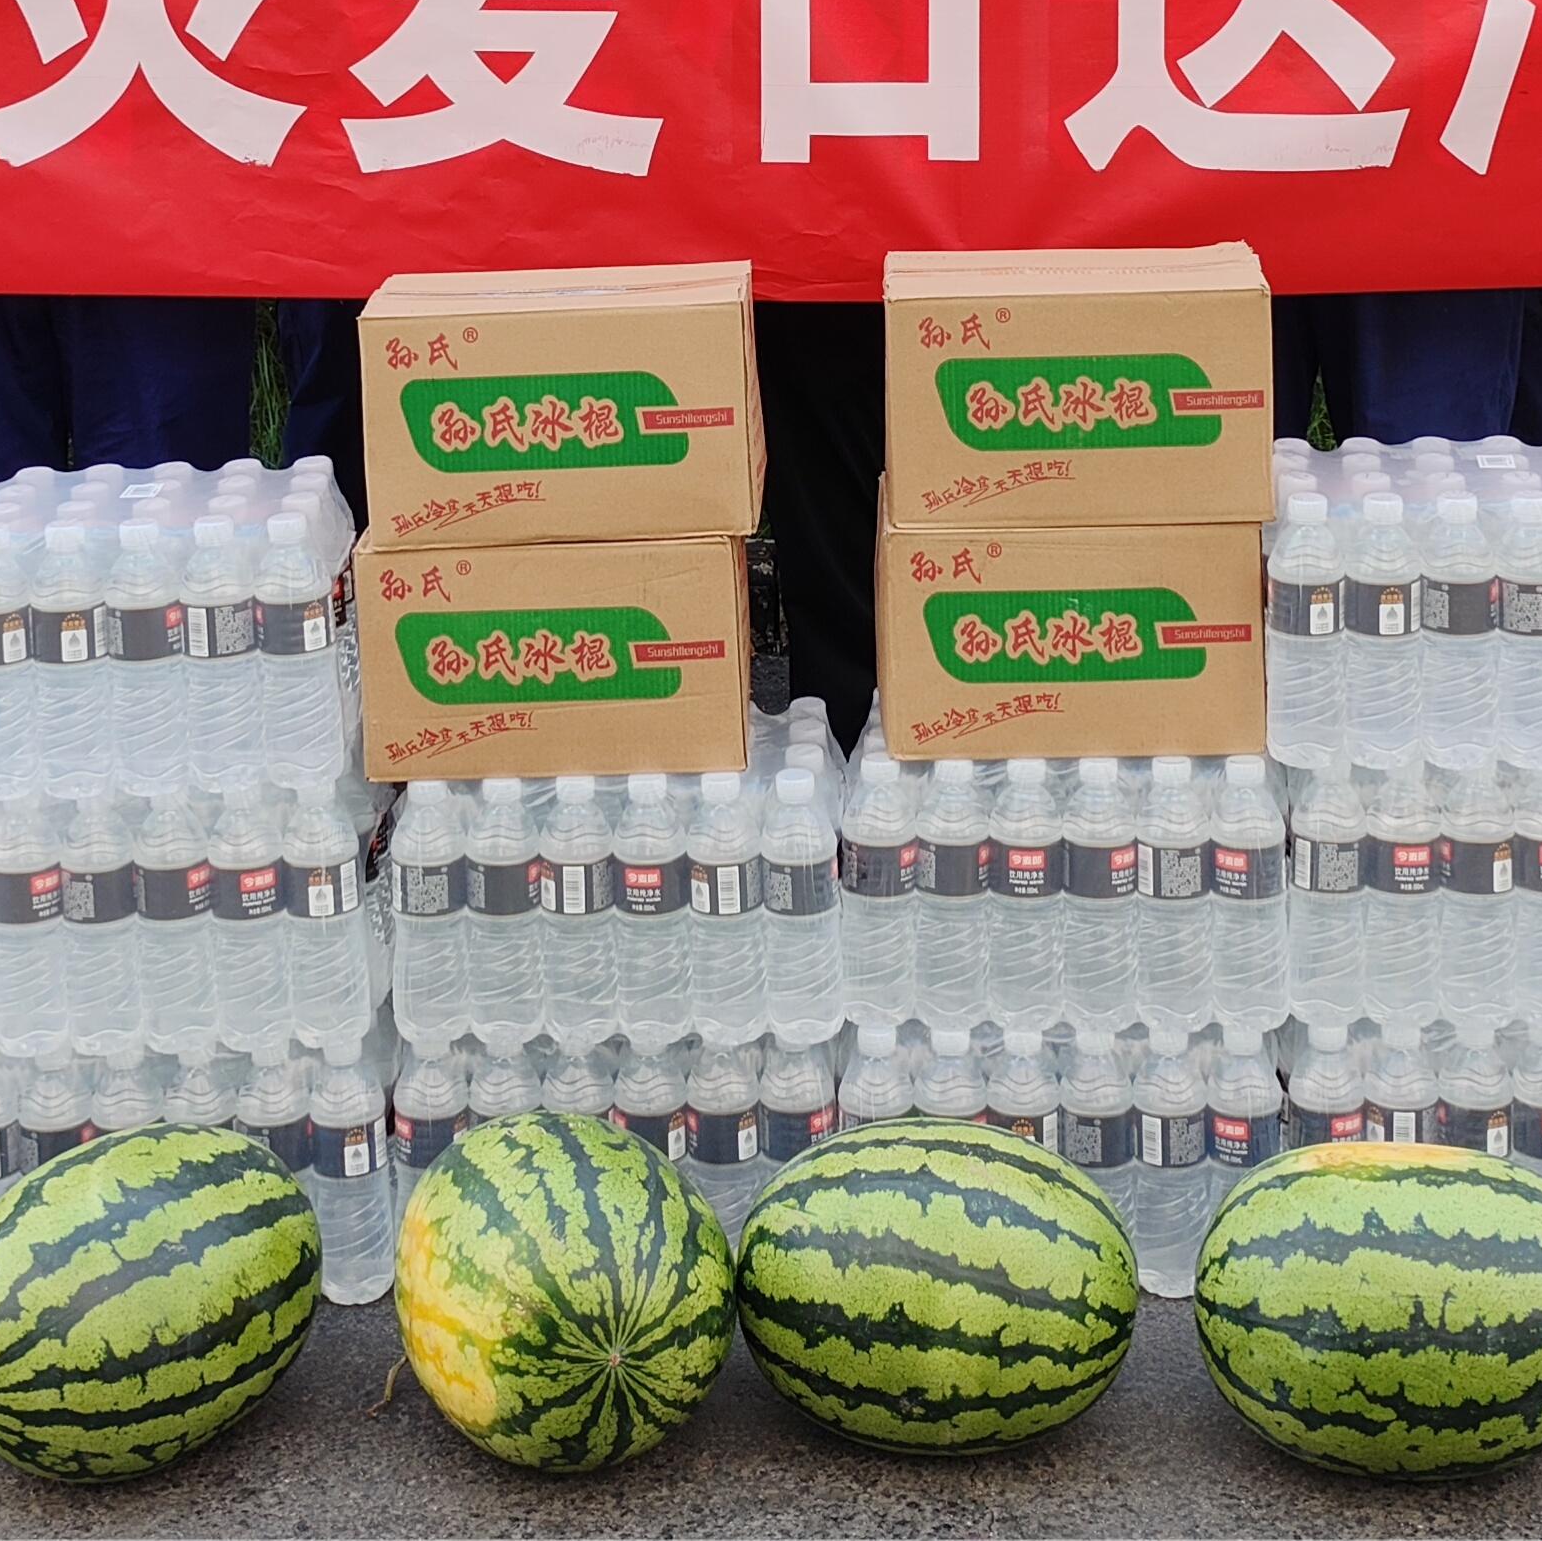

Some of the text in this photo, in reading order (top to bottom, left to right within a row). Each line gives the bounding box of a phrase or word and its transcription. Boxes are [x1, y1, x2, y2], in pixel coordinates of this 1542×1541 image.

[435, 399, 619, 448] 孙氏冰棍
[968, 380, 1152, 427] 孙氏冰棍
[430, 632, 613, 680] 孙氏冰棍
[958, 614, 1139, 660] 孙氏冰棍
